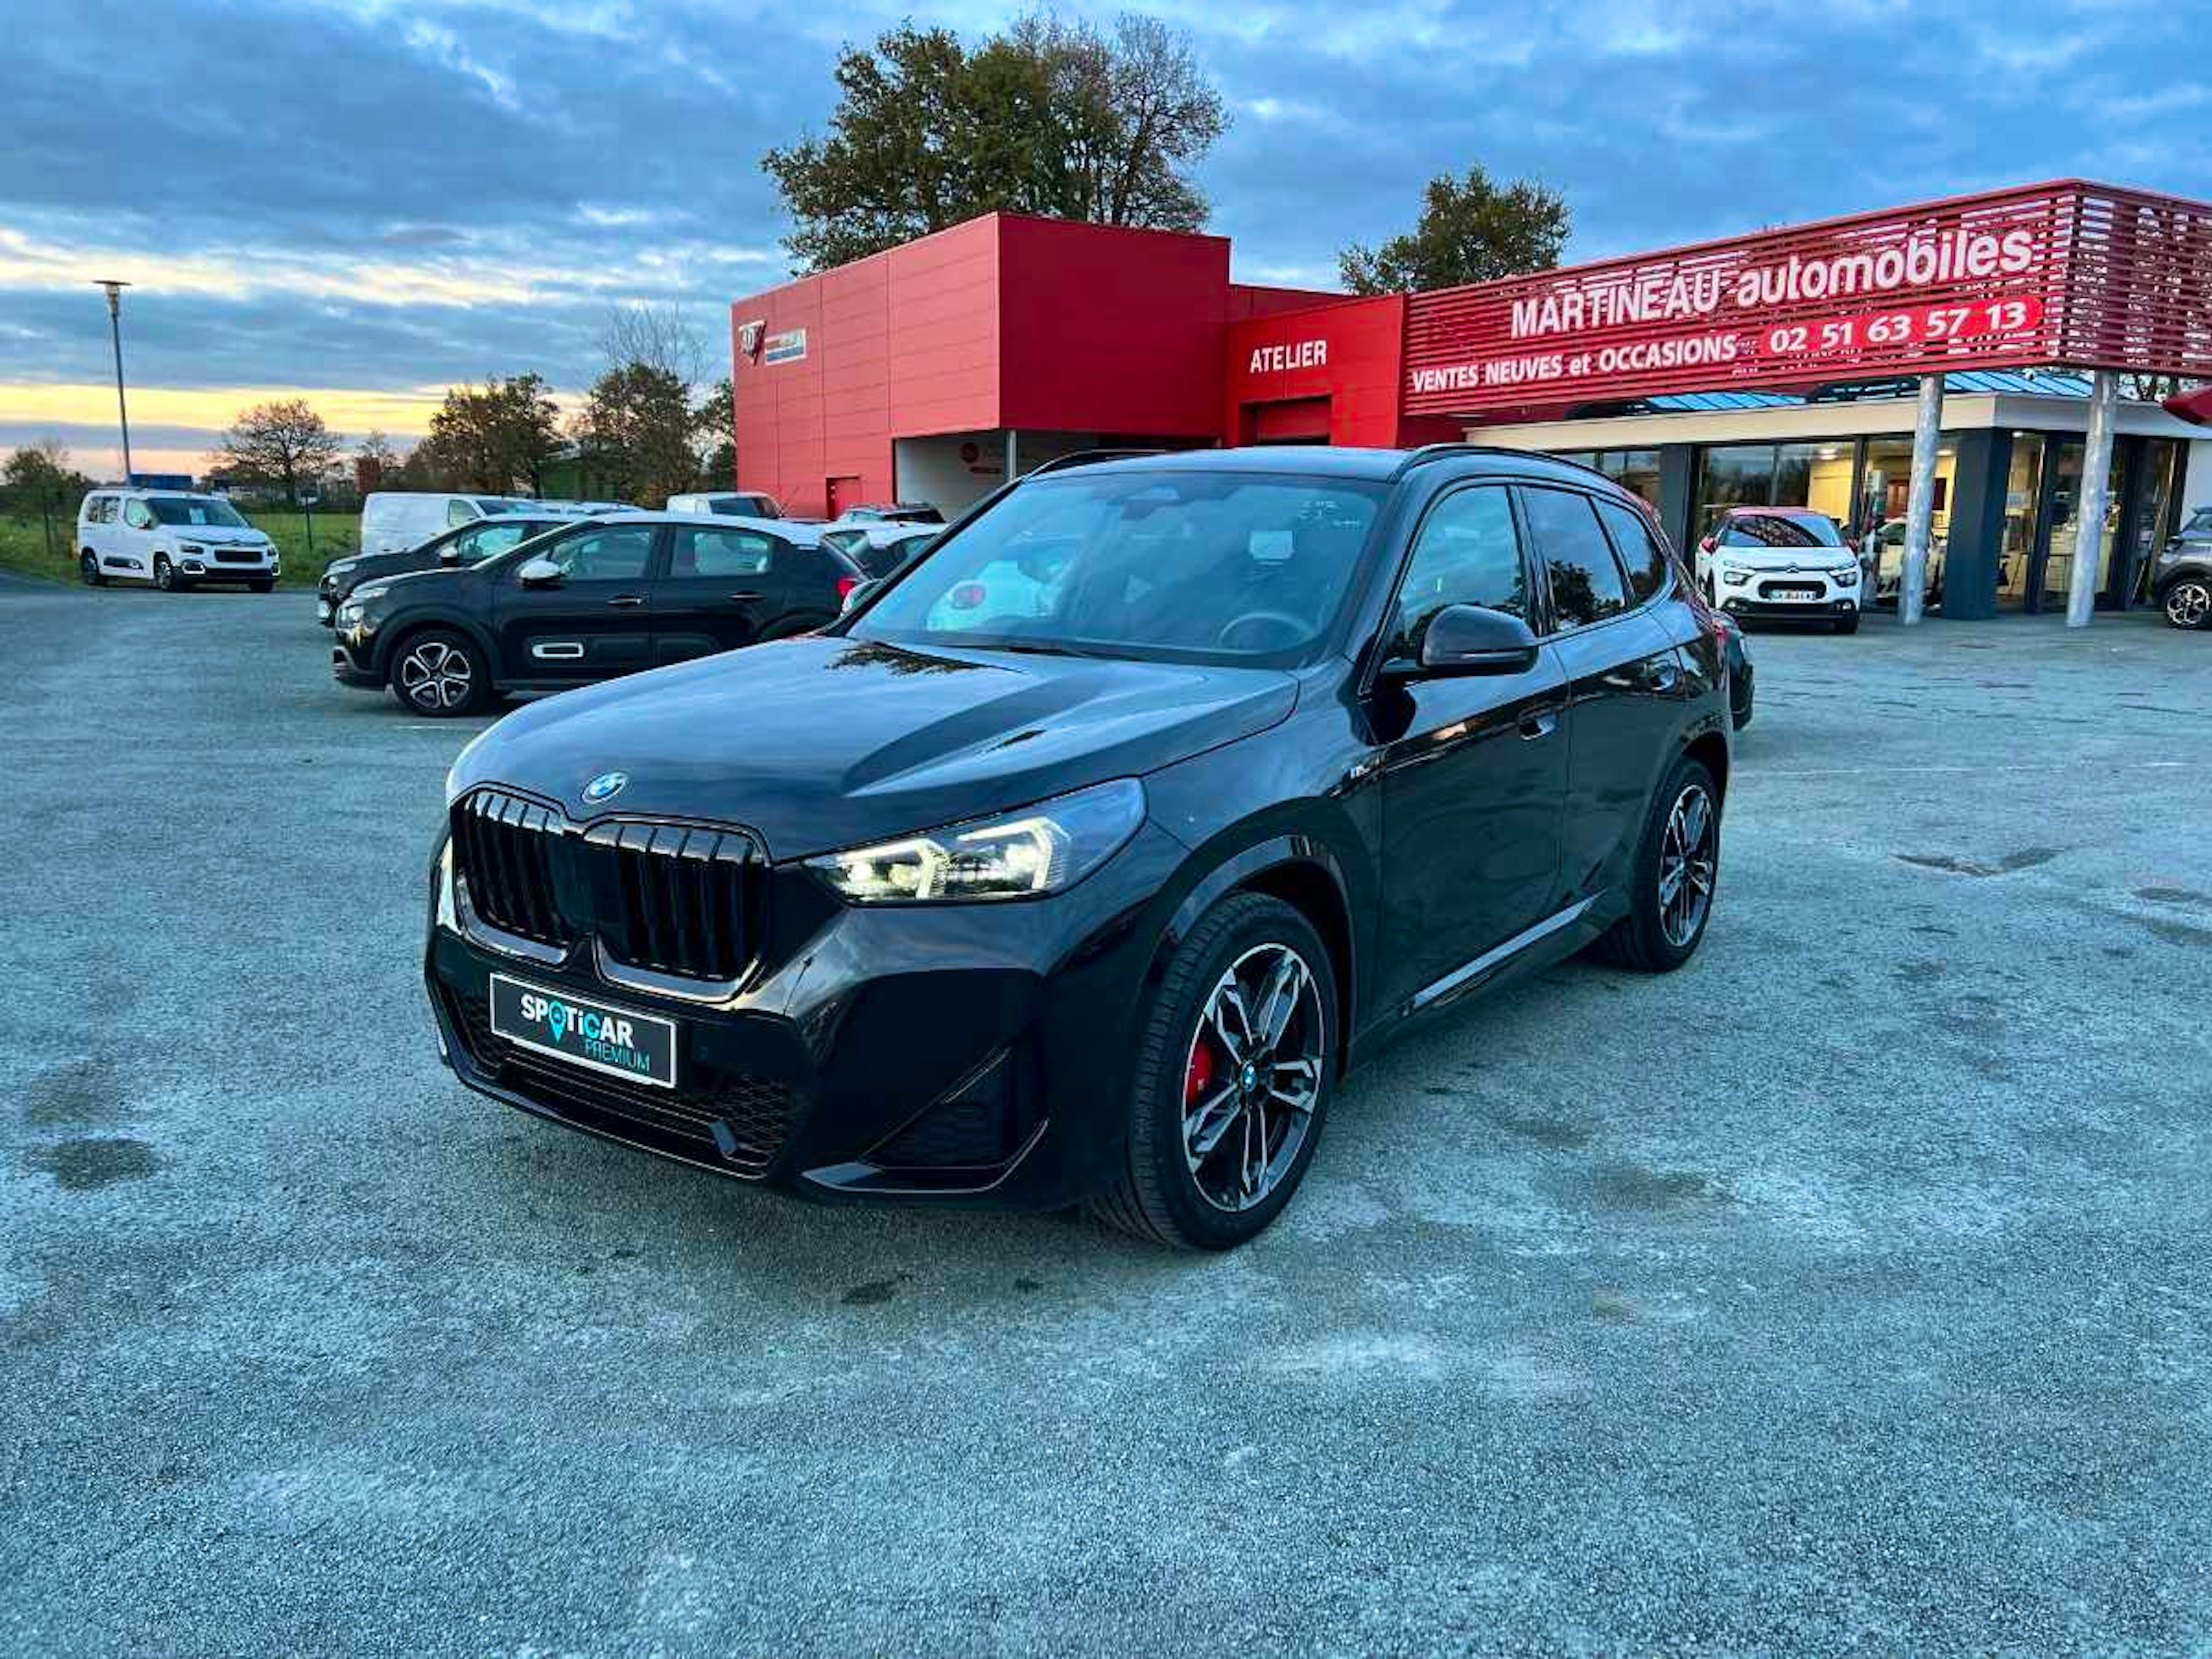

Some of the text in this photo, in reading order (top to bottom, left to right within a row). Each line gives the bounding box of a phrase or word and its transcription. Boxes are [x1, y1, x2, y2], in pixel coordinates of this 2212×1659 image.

[1510, 230, 2033, 340] MARTINEAU automobiles
[1770, 301, 2027, 353] 02 51 63 57 13
[1249, 339, 1327, 374] ATELIER
[1412, 334, 1737, 393] VENTES NEUVES et OCCASIONS
[585, 1038, 651, 1073] PREMIUM
